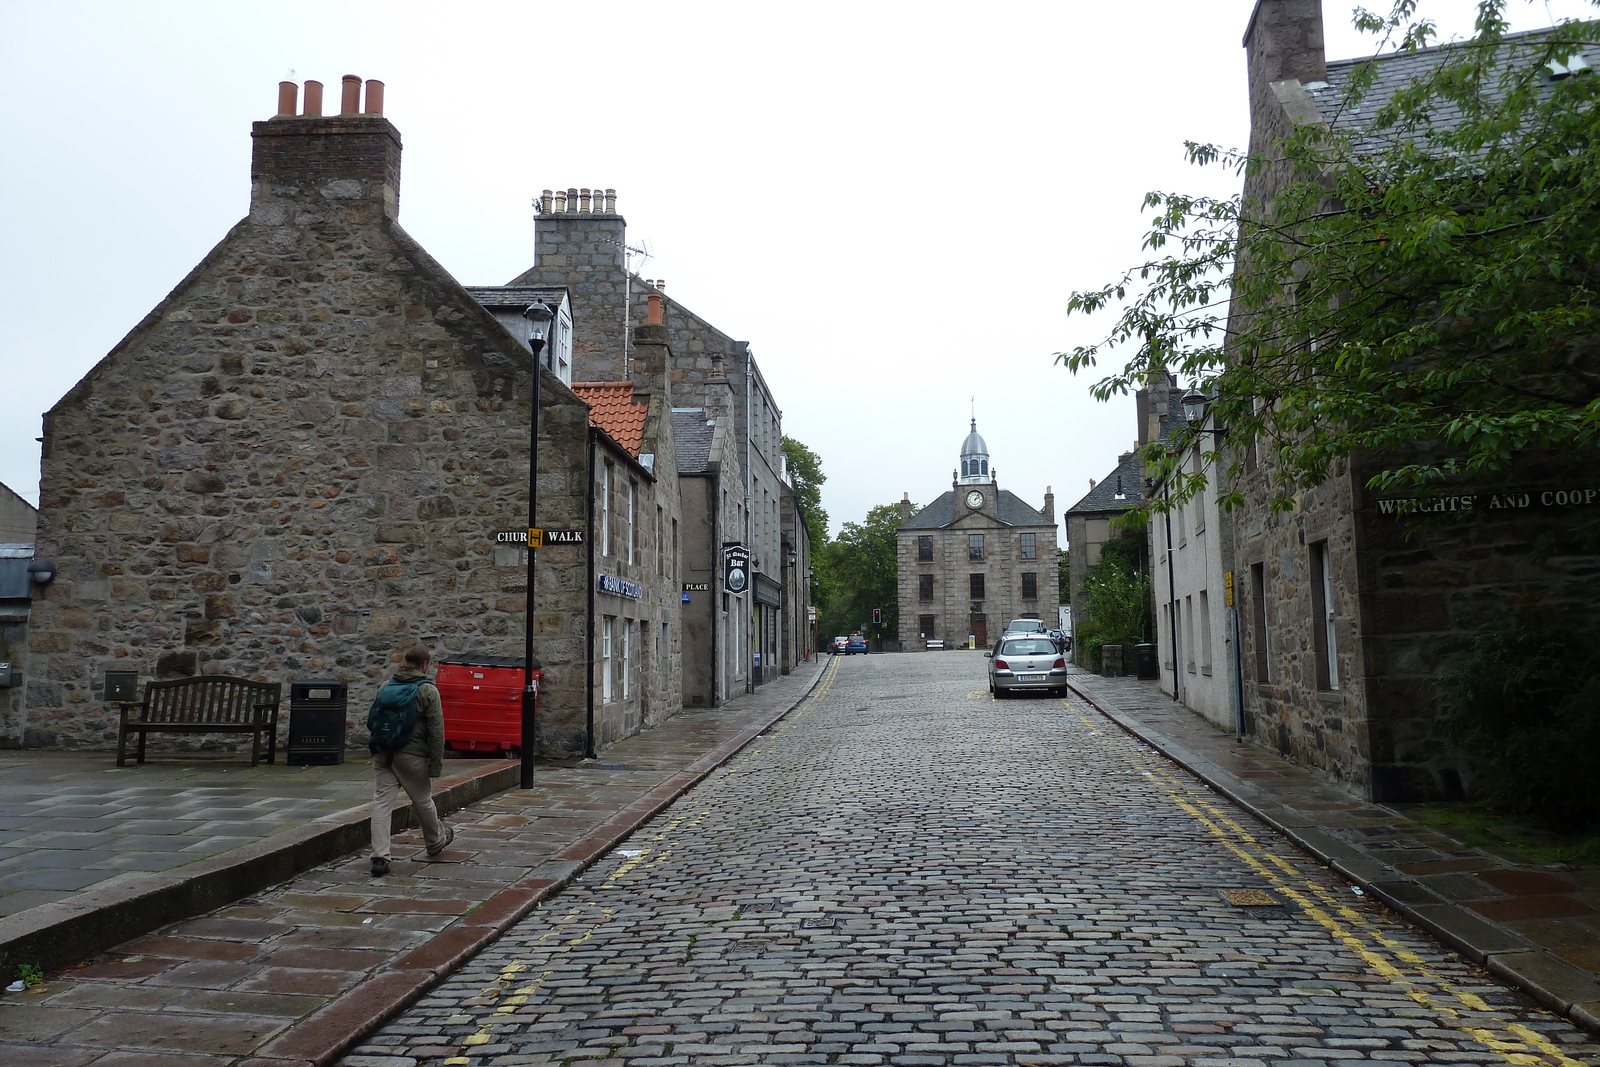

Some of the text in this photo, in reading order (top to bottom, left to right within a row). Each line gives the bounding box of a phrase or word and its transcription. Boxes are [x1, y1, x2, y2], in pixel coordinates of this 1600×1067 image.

[1489, 493, 1530, 509] AND
[1541, 489, 1600, 506] COOP
[497, 531, 583, 542] CHUR WALK
[530, 530, 542, 546] H
[730, 559, 745, 567] Bar
[686, 583, 709, 591] PLACE
